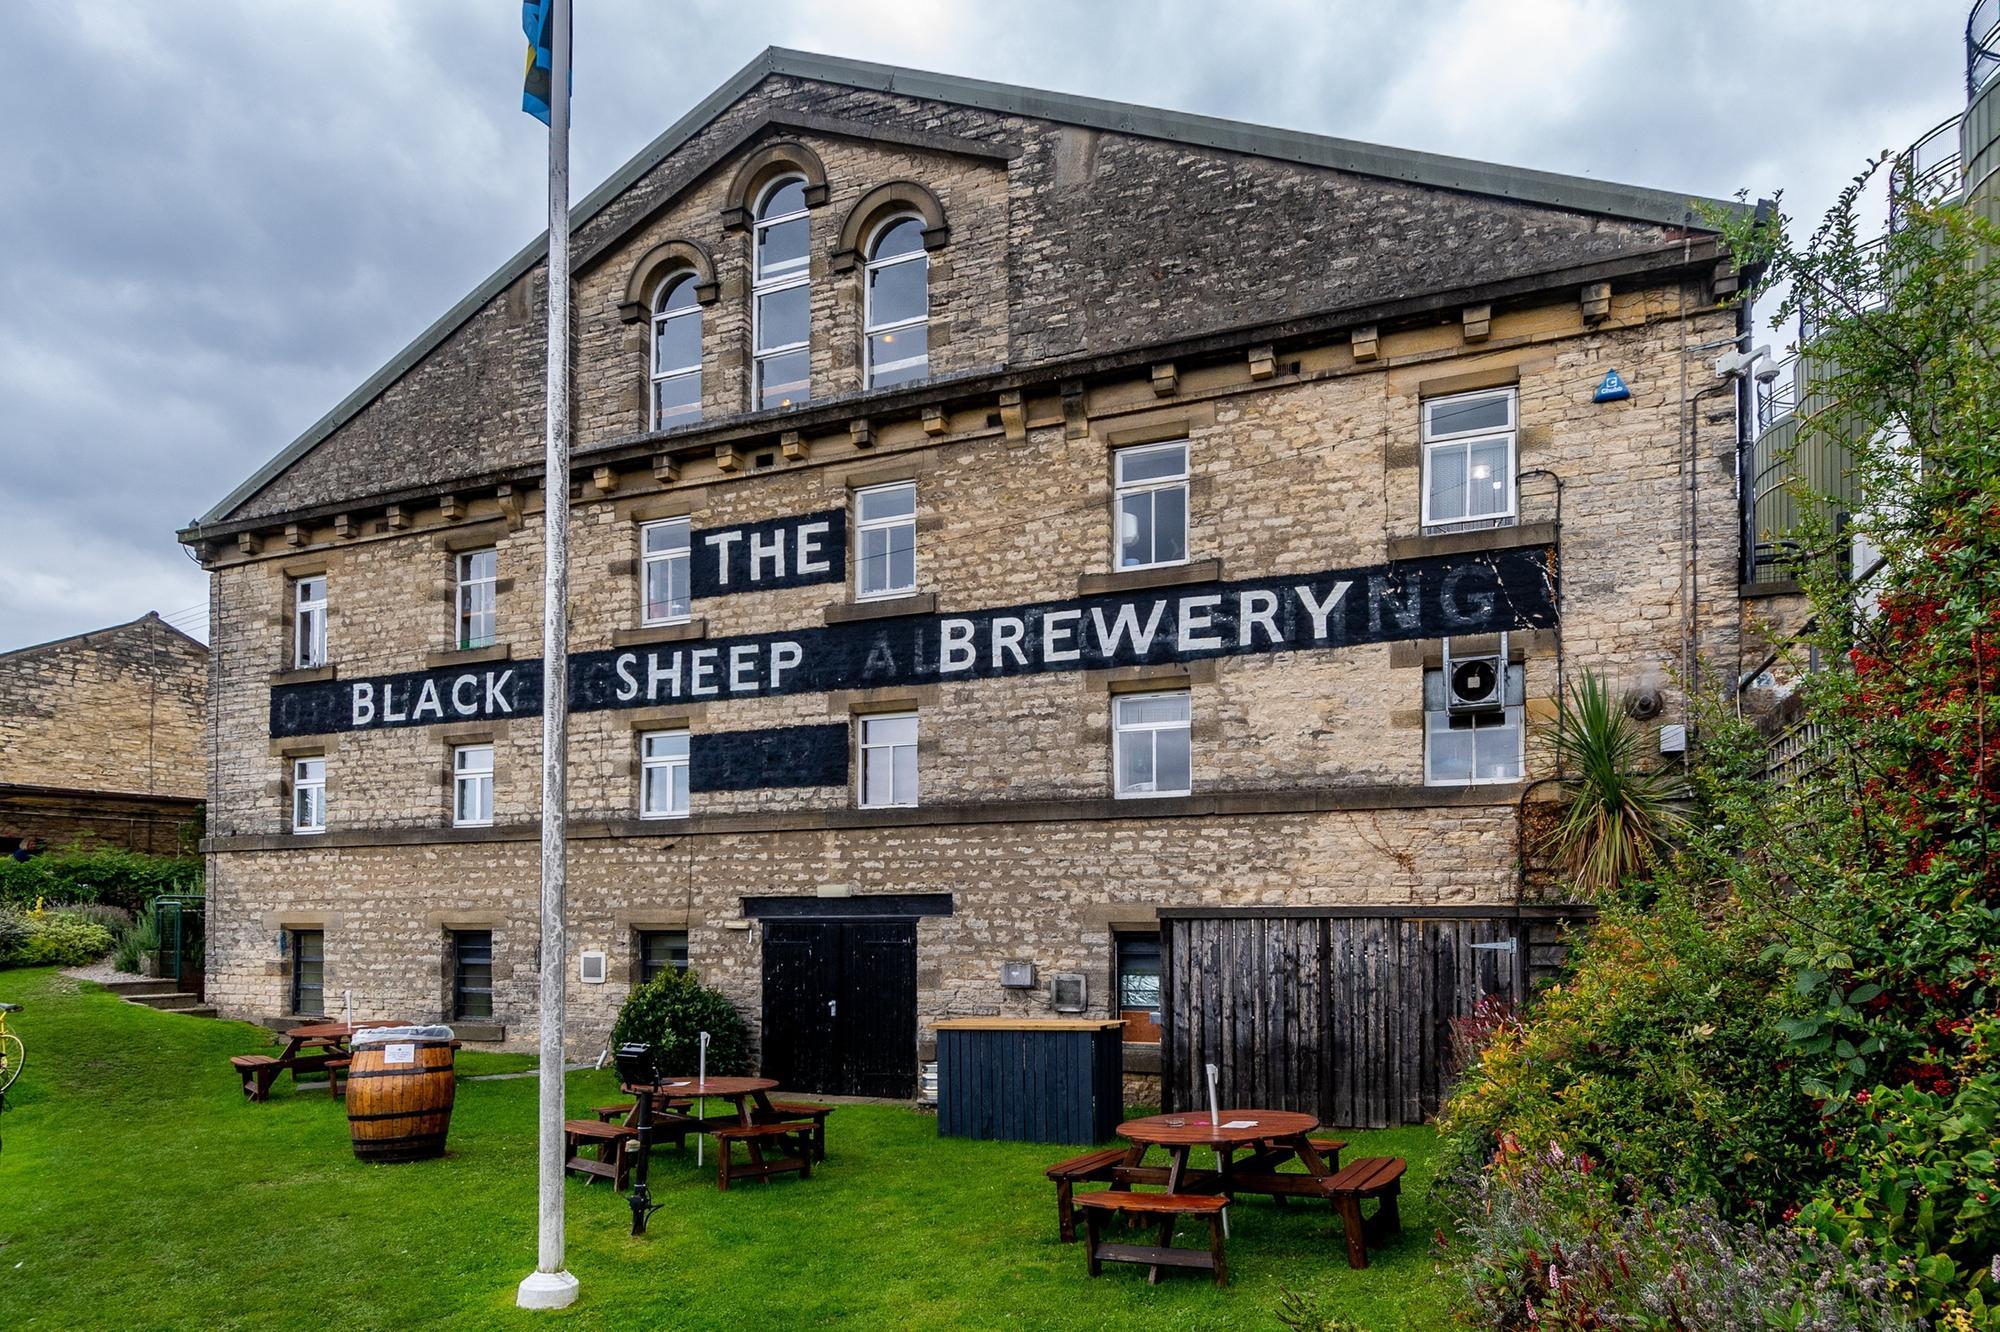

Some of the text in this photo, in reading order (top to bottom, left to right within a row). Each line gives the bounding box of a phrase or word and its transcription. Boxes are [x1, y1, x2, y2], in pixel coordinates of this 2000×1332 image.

[706, 522, 830, 584] THE
[352, 670, 514, 726] BLACK
[616, 641, 803, 701] SHEEP
[939, 580, 1355, 673] BREWERY
